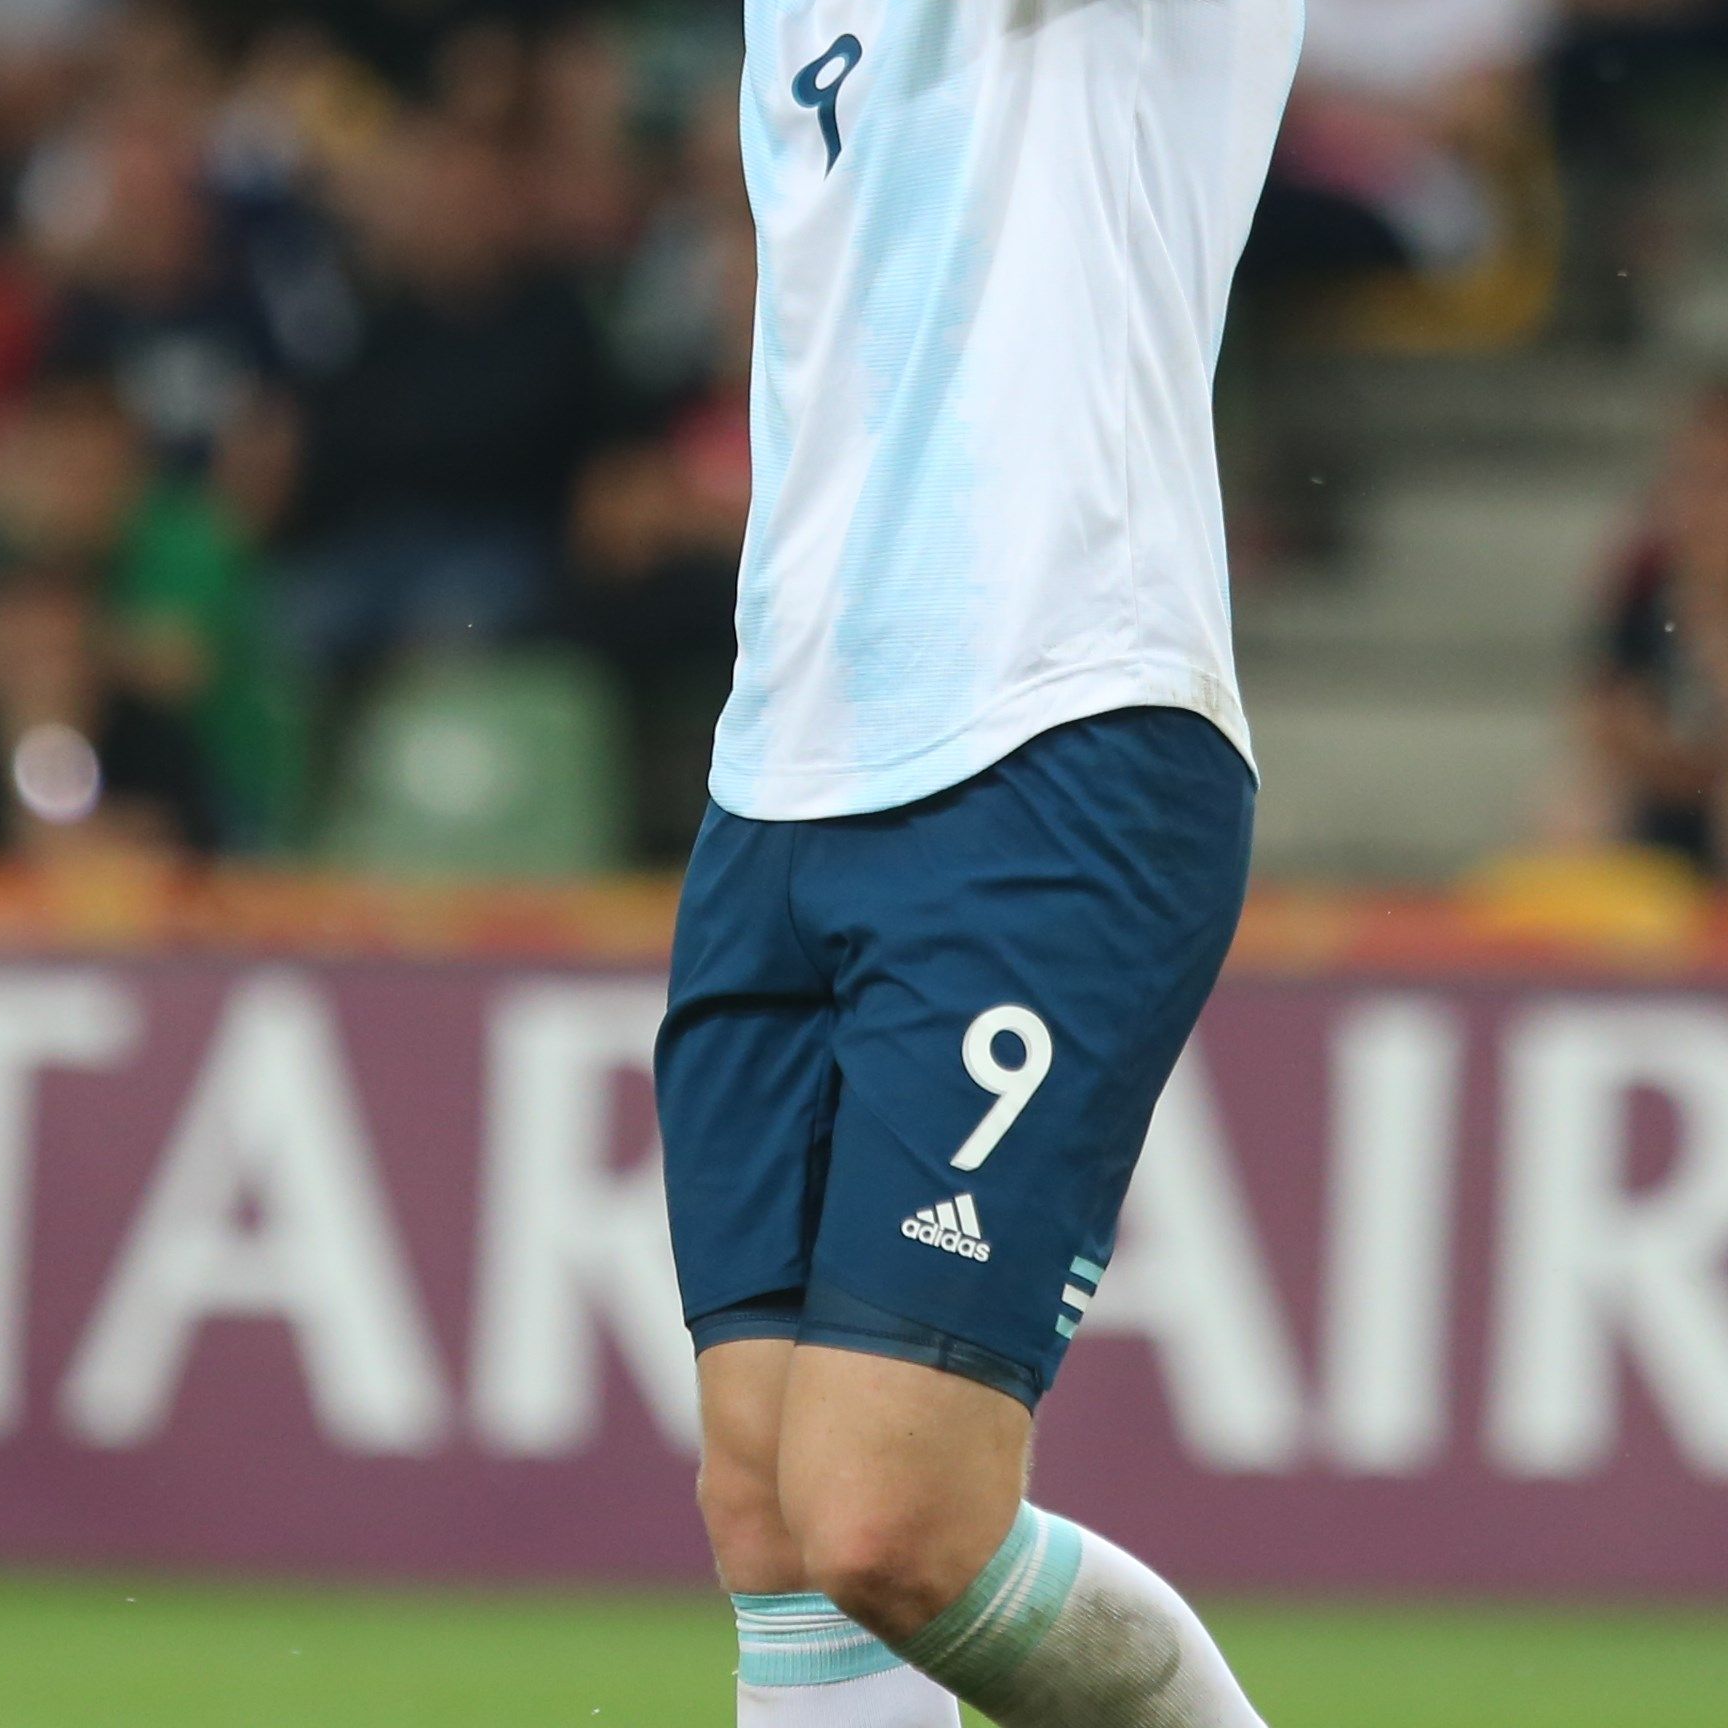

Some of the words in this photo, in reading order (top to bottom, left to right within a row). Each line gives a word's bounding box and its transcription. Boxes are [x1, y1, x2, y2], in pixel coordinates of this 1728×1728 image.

[790, 32, 863, 182] 9
[949, 1004, 1053, 1172] 9
[901, 1216, 991, 1264] adidas
